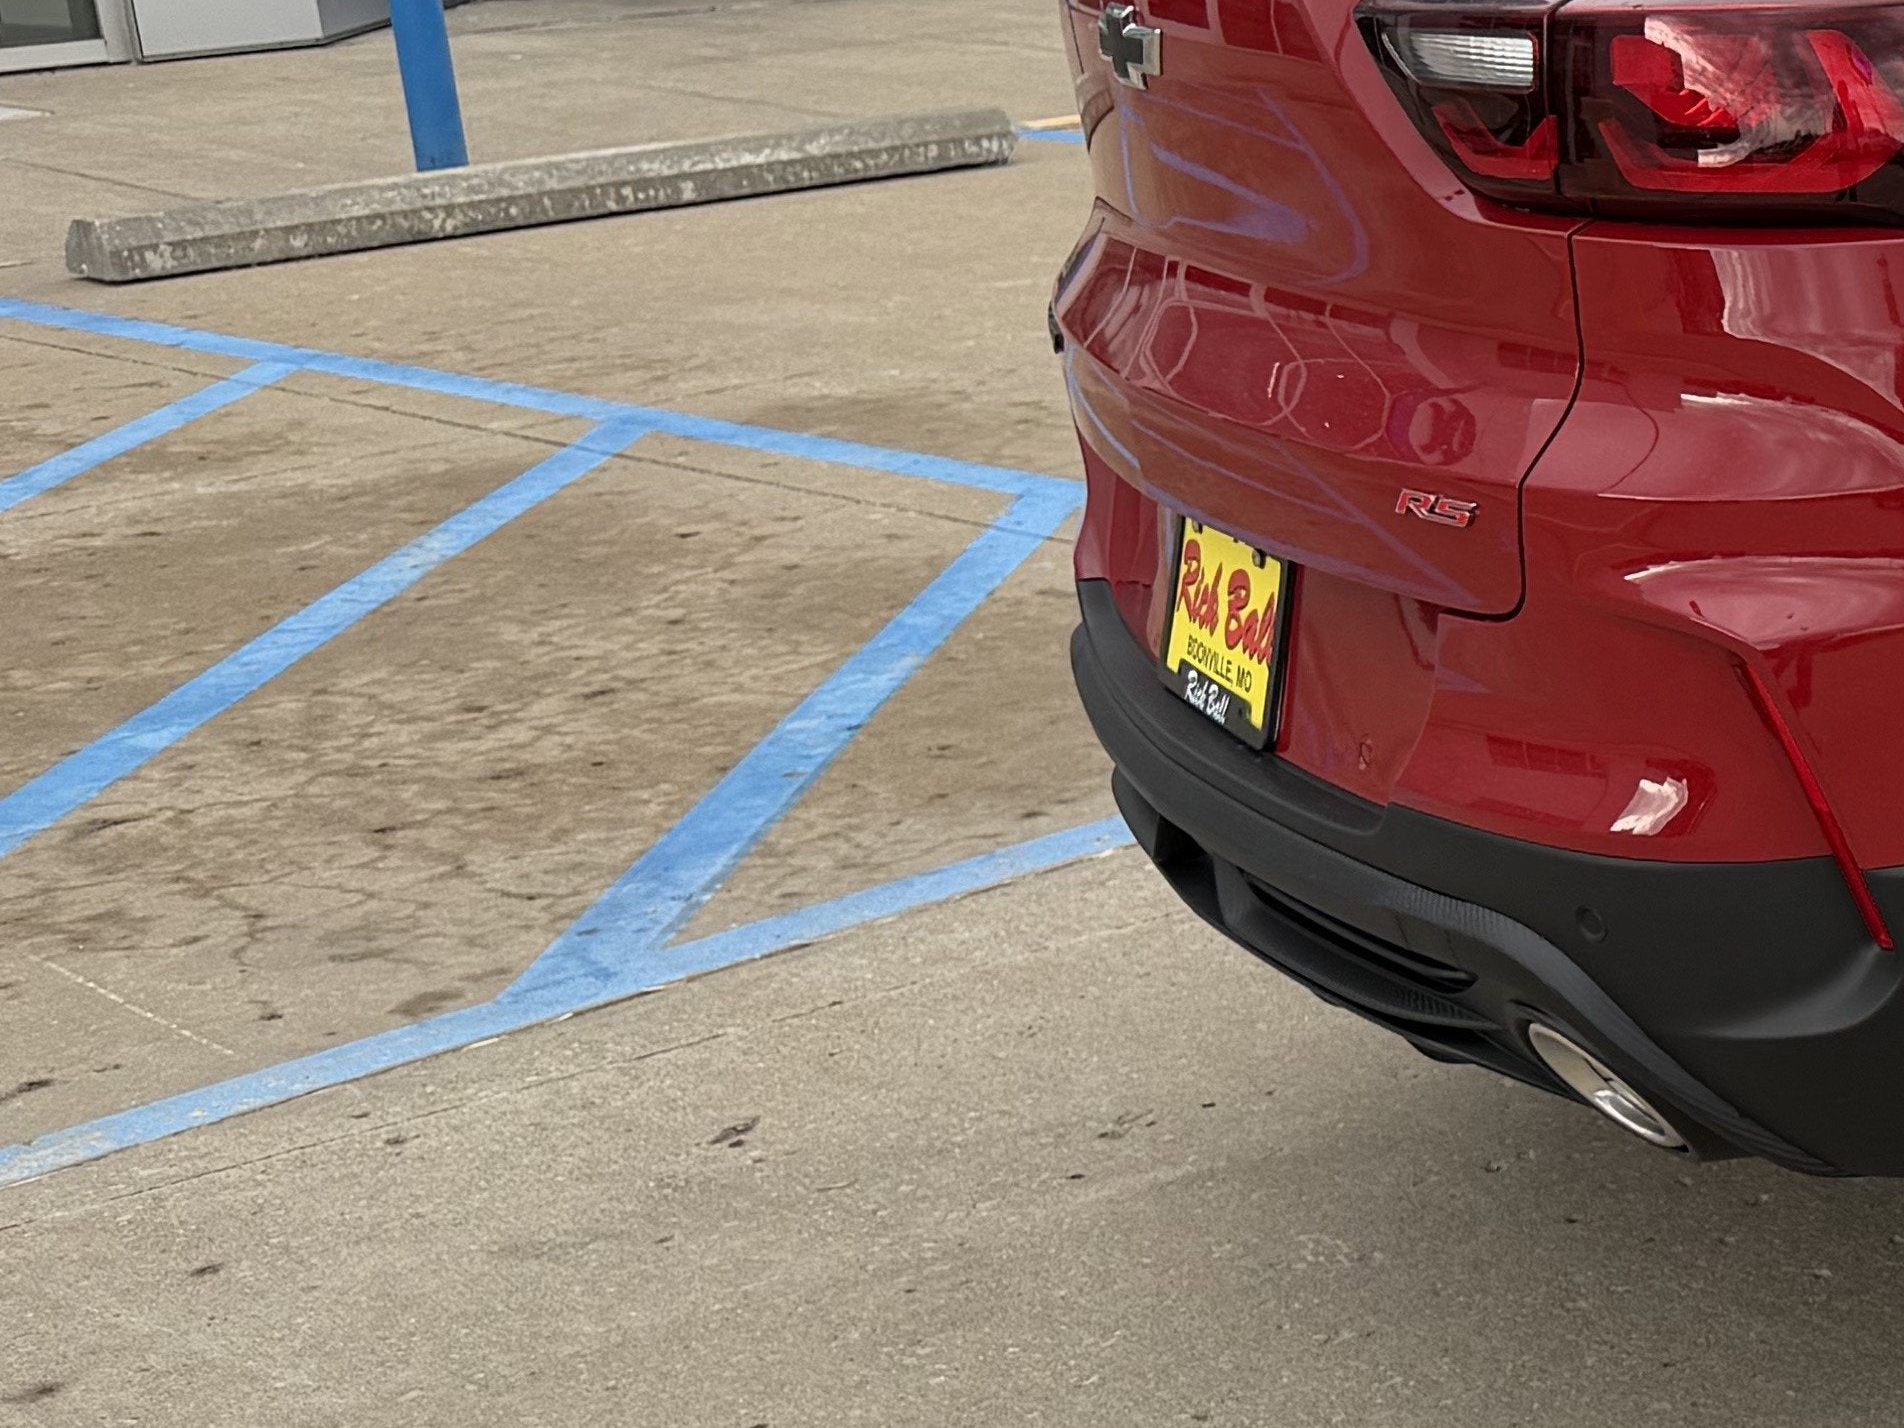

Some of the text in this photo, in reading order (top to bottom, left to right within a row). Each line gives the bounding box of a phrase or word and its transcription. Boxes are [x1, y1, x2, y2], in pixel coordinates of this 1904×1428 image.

[1395, 488, 1477, 528] RS
[1177, 539, 1222, 637] Rick
[1184, 669, 1231, 724] Rick Ball
[1236, 664, 1252, 694] MO
